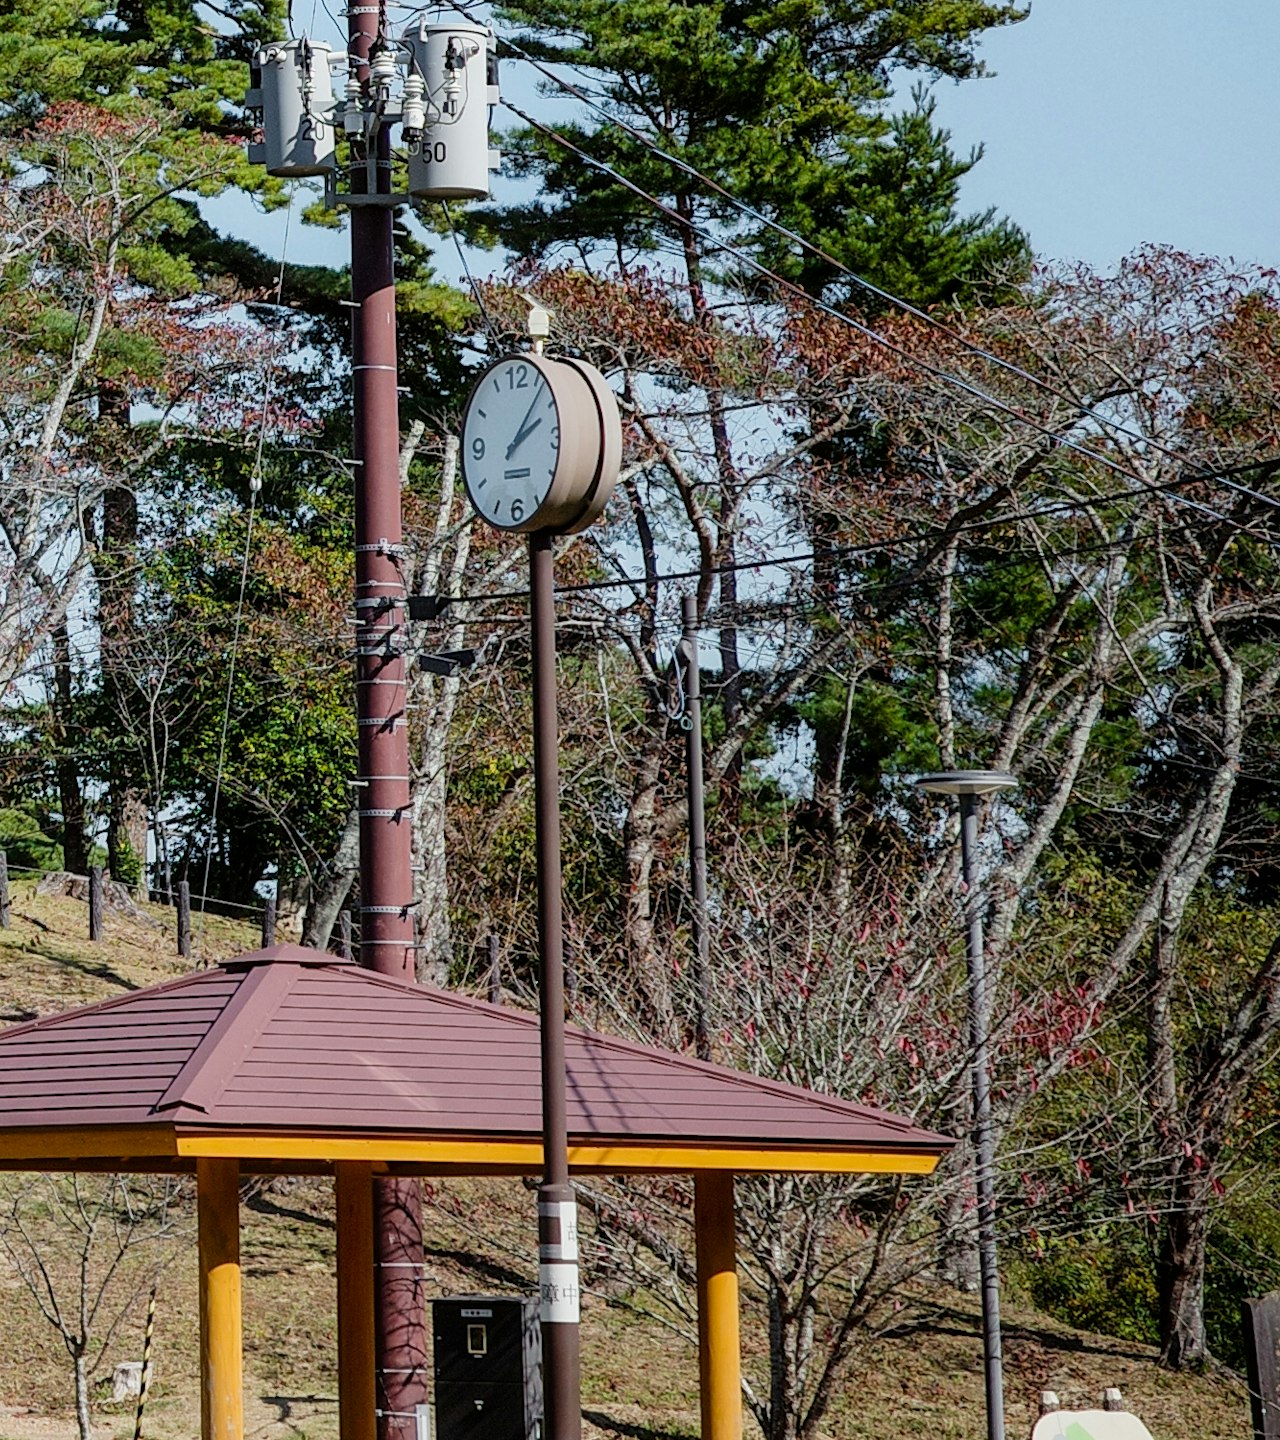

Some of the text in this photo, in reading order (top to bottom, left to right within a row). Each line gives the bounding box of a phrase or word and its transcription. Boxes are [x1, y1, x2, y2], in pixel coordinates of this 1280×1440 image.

[422, 141, 447, 164] 50
[505, 364, 529, 390] 12
[472, 437, 486, 461] 9
[550, 426, 560, 450] 3
[510, 498, 524, 522] 6
